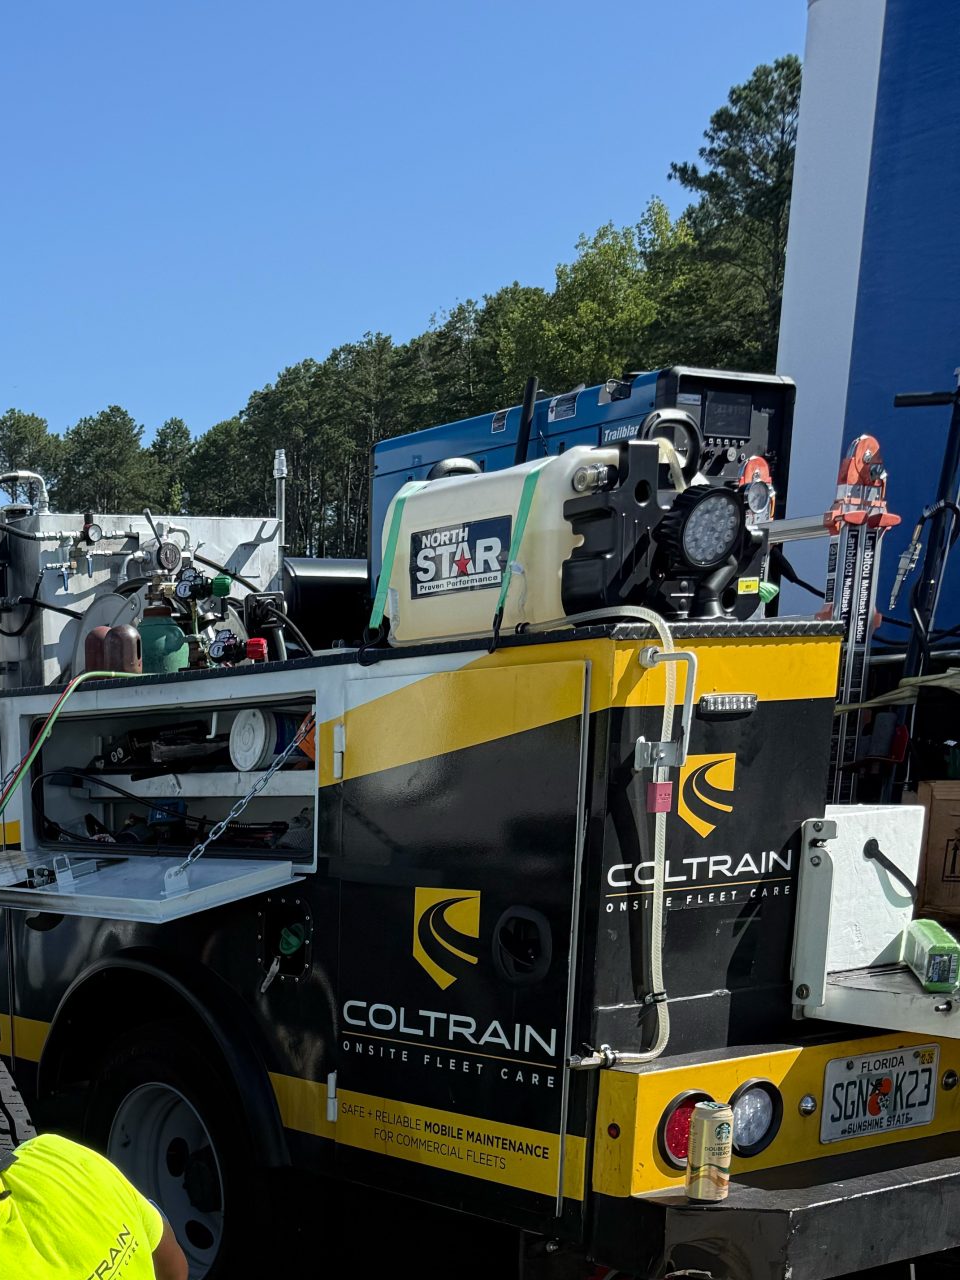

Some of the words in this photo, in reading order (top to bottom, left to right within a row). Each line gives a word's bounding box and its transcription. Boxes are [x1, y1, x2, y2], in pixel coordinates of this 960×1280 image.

[604, 424, 640, 442] Trailblaz
[421, 527, 469, 548] NORTH
[845, 531, 858, 575] Lanbitou
[862, 532, 876, 576] Lanbitou
[416, 537, 502, 582] STAR
[419, 582, 445, 592] Proven
[446, 575, 498, 588] Performance
[841, 578, 852, 613] Multitask
[858, 581, 869, 613] Multitask
[855, 613, 866, 642] Ladder
[606, 849, 792, 887] COLTRAIN
[605, 896, 672, 913] ONSIE
[686, 890, 738, 905] FLEET
[749, 885, 790, 898] CARE
[342, 1000, 557, 1057] COLTRAIN
[343, 1040, 408, 1062] ONSITE
[424, 1055, 483, 1075] FLEET
[501, 1068, 555, 1088] CARE
[861, 1056, 905, 1073] FLORIDA
[830, 1078, 870, 1123] SGN
[893, 1068, 933, 1111] K23
[341, 1102, 365, 1119] SAFE
[375, 1109, 421, 1131] RELIABLE
[424, 1121, 464, 1140] MOBILE
[466, 1130, 549, 1160] MAINTENANCE
[847, 1117, 884, 1135] SUNSHINE
[886, 1112, 910, 1127] STATE
[374, 1127, 394, 1143] FOR
[396, 1132, 464, 1160] COMMERCIAL
[466, 1150, 506, 1169] FLEETS
[124, 1240, 139, 1266] CARE
